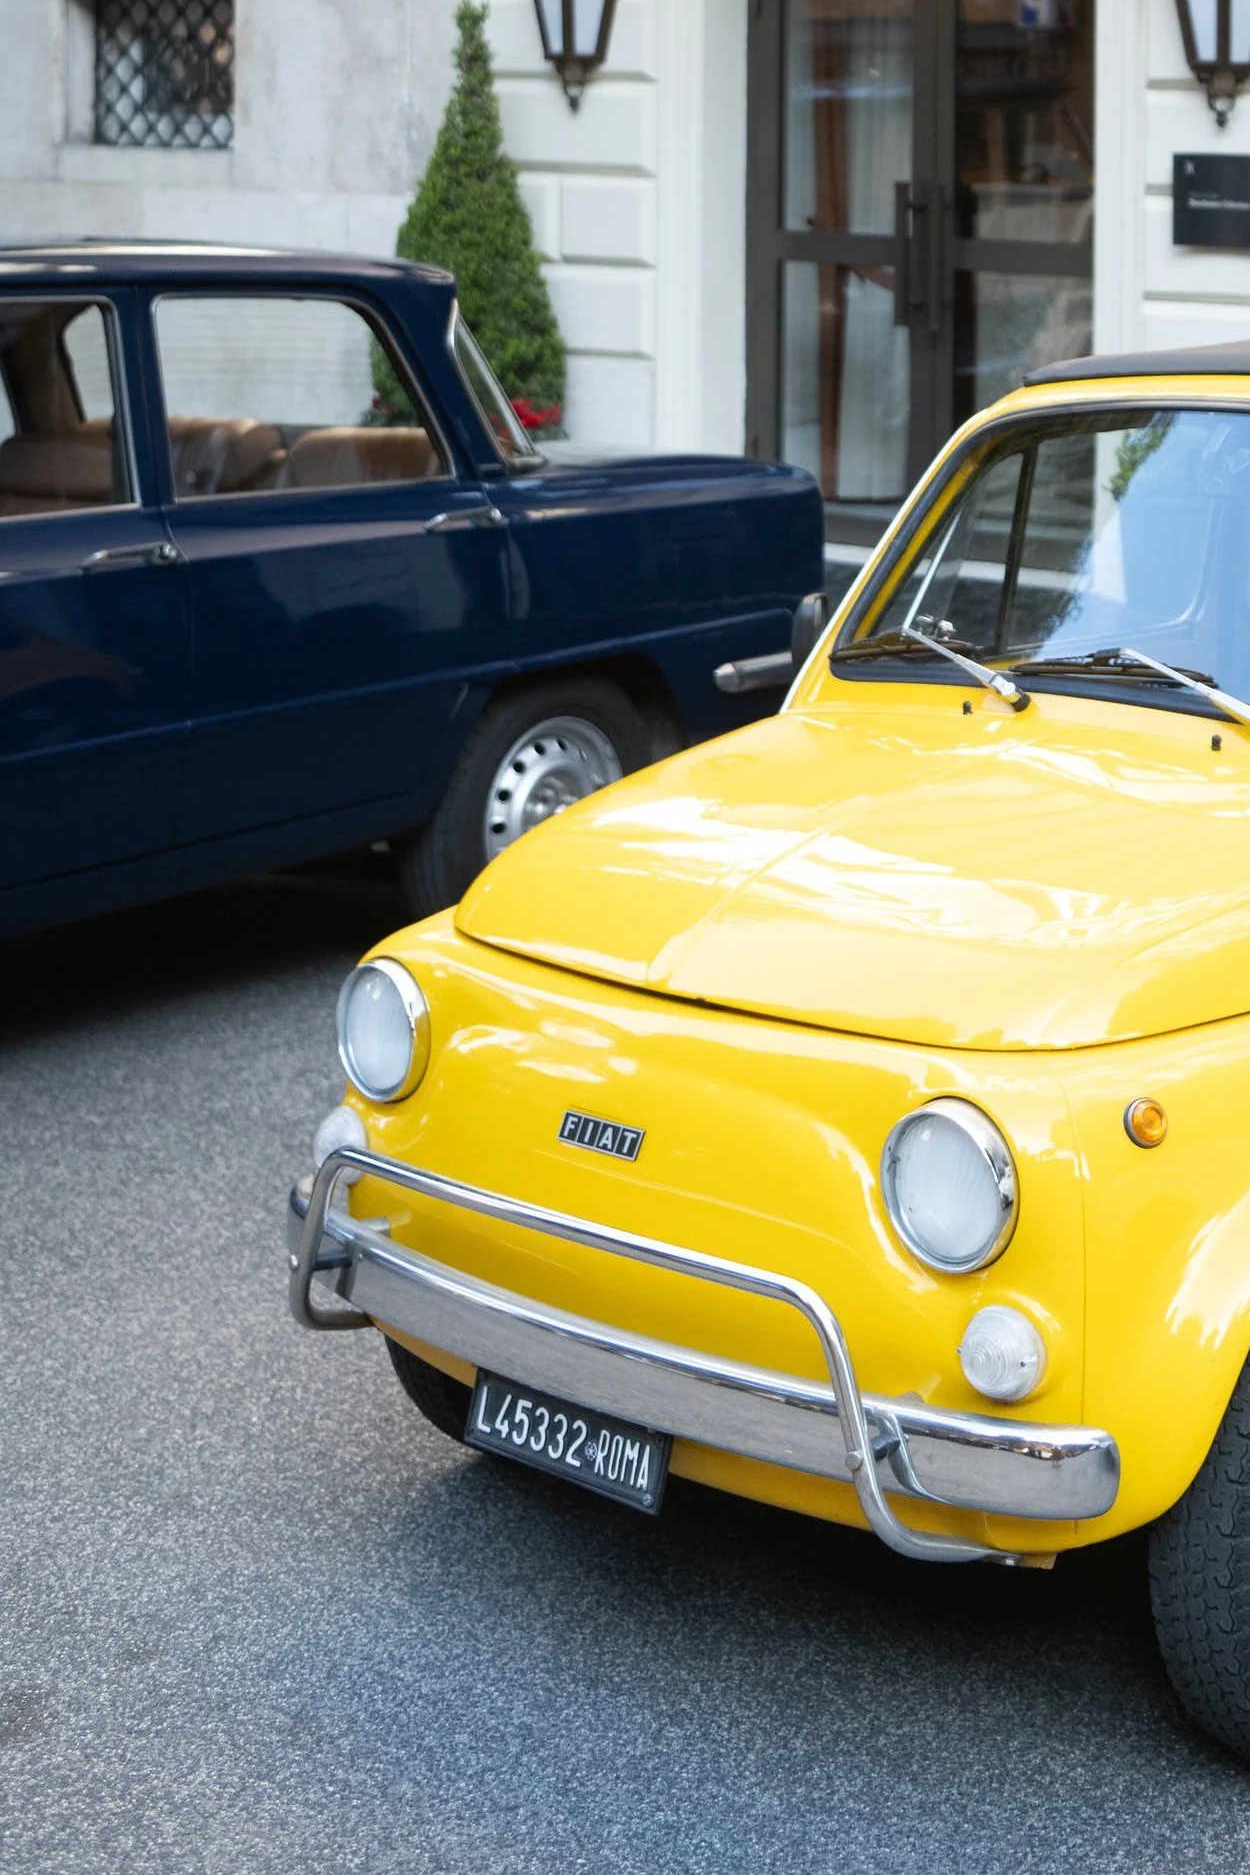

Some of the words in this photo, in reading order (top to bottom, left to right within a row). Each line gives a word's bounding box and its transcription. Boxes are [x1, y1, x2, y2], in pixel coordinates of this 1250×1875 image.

[563, 1115, 638, 1154] FIAT
[476, 1385, 587, 1468] L45332
[594, 1429, 651, 1491] ROMA
